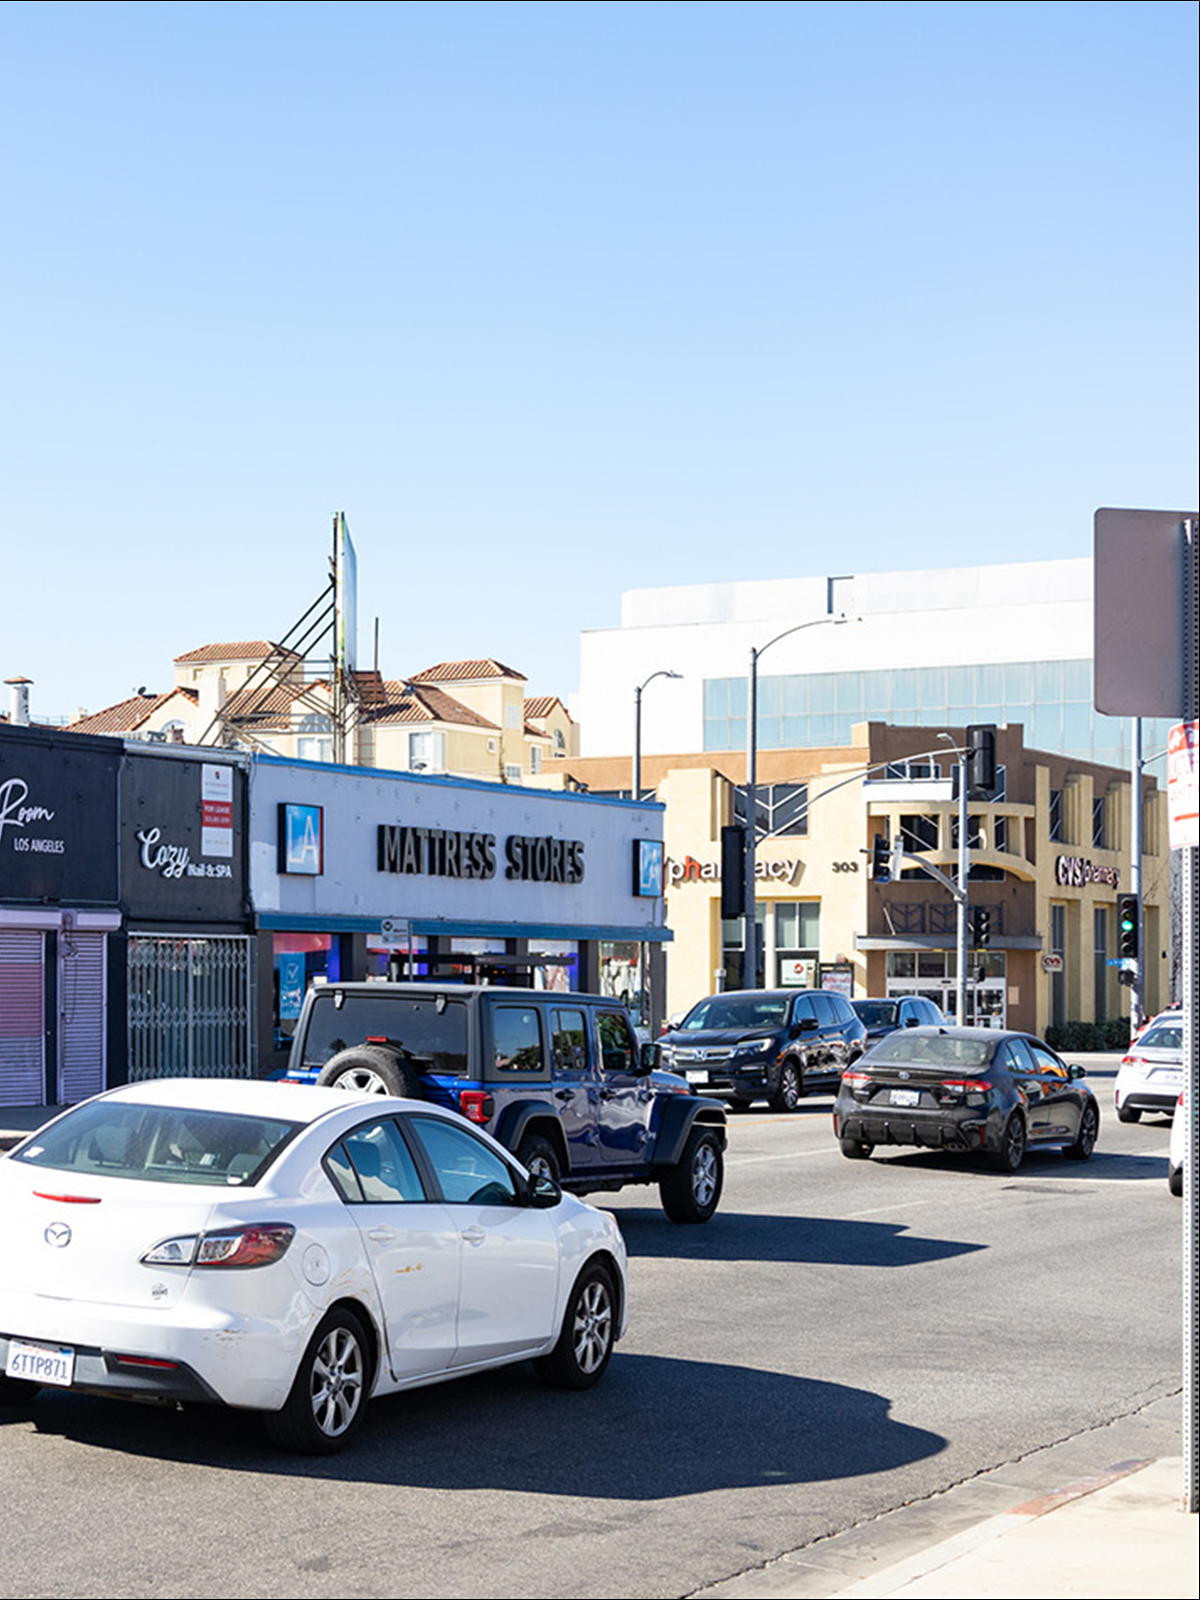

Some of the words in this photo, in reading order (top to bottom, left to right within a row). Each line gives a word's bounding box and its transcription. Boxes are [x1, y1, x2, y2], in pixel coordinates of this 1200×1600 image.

[13, 837, 30, 851] LOS
[30, 839, 65, 853] ANGELES
[137, 827, 190, 878] Cozy
[288, 814, 318, 864] LA
[377, 824, 497, 880] MATTRESS
[504, 834, 585, 884] STORES
[187, 863, 205, 876] Nail
[640, 847, 661, 889] LA
[668, 855, 800, 886] phaacy
[831, 861, 858, 873] 303
[11, 1353, 68, 1379] 6TTP871
